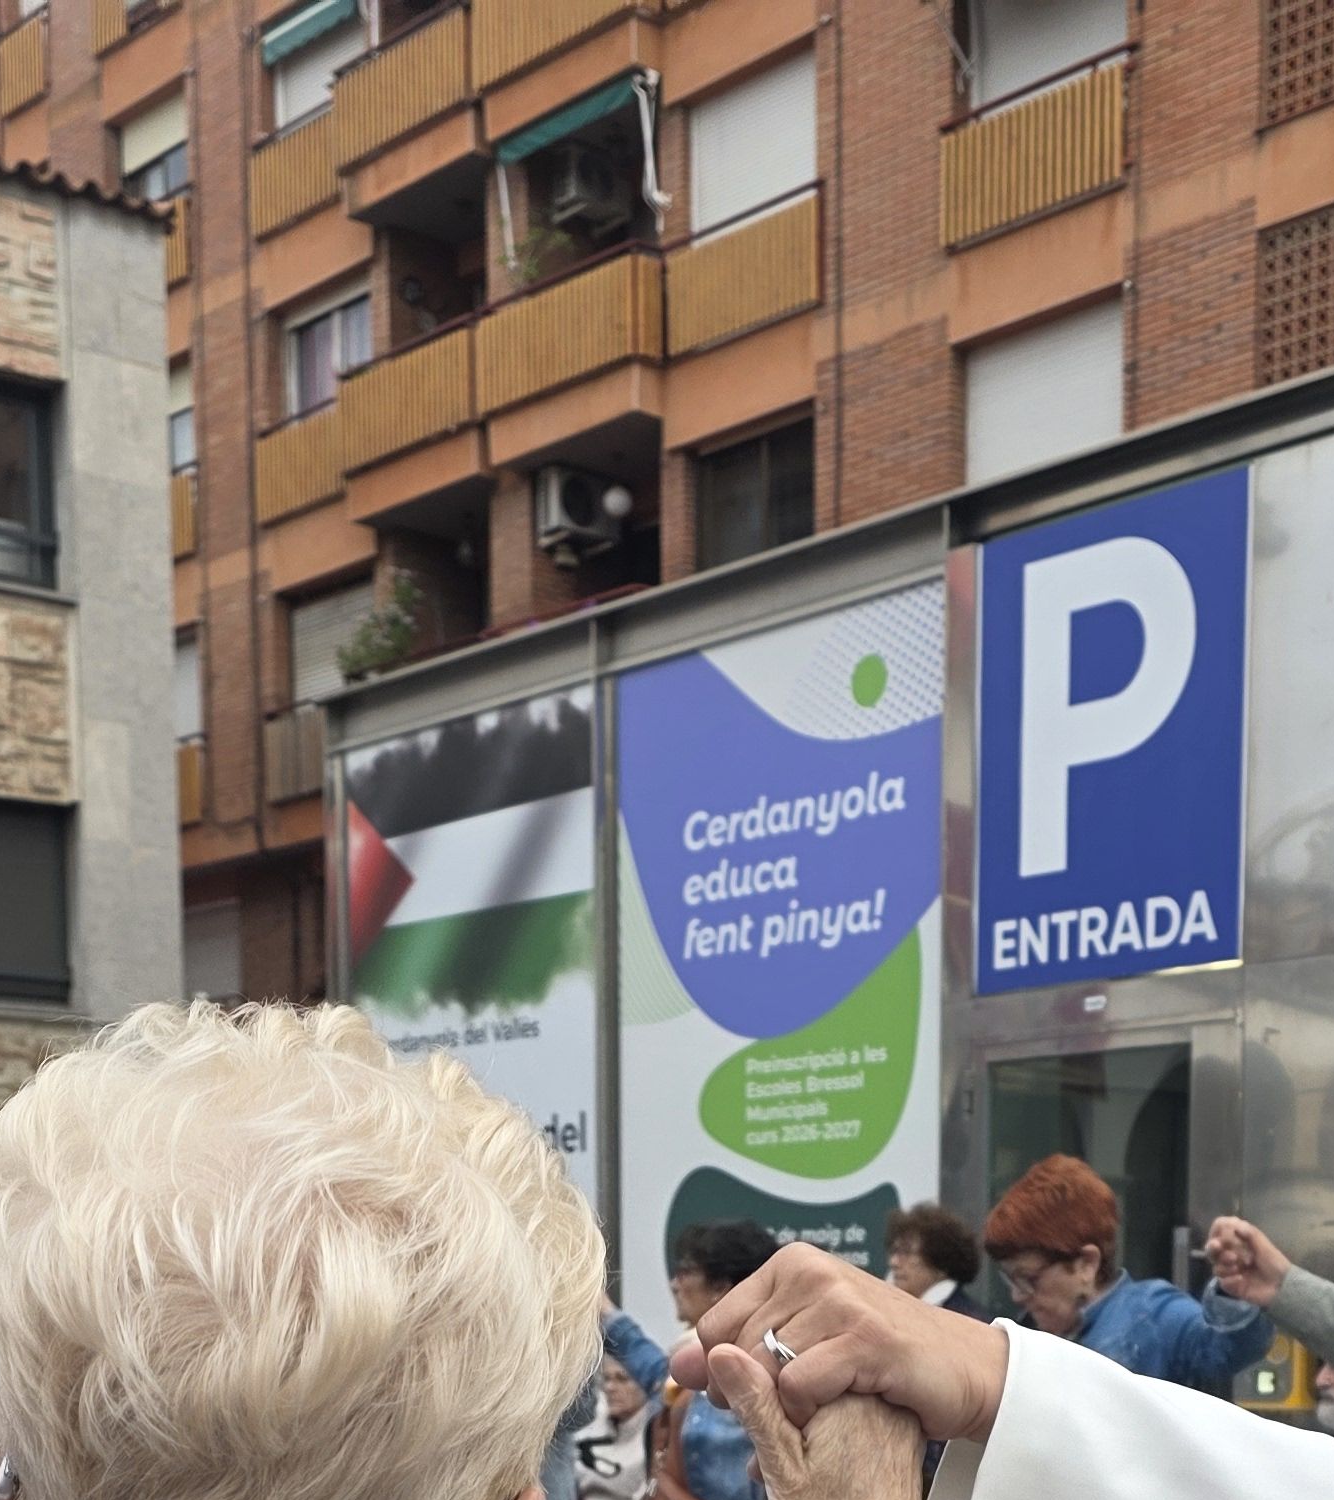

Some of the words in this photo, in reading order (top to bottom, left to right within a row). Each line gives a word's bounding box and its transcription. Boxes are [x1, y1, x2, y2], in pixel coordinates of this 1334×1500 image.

[1019, 536, 1197, 878] P
[683, 770, 906, 850] Cerdanyola
[683, 856, 798, 905] educa
[683, 914, 754, 960] fent
[760, 888, 886, 957] pinya!
[993, 889, 1219, 971] ENTRADA
[850, 1050, 861, 1066] a
[746, 1078, 803, 1099] Escoles
[806, 1071, 865, 1094] Bressol
[746, 1099, 829, 1122] Municipals
[845, 1223, 866, 1242] de
